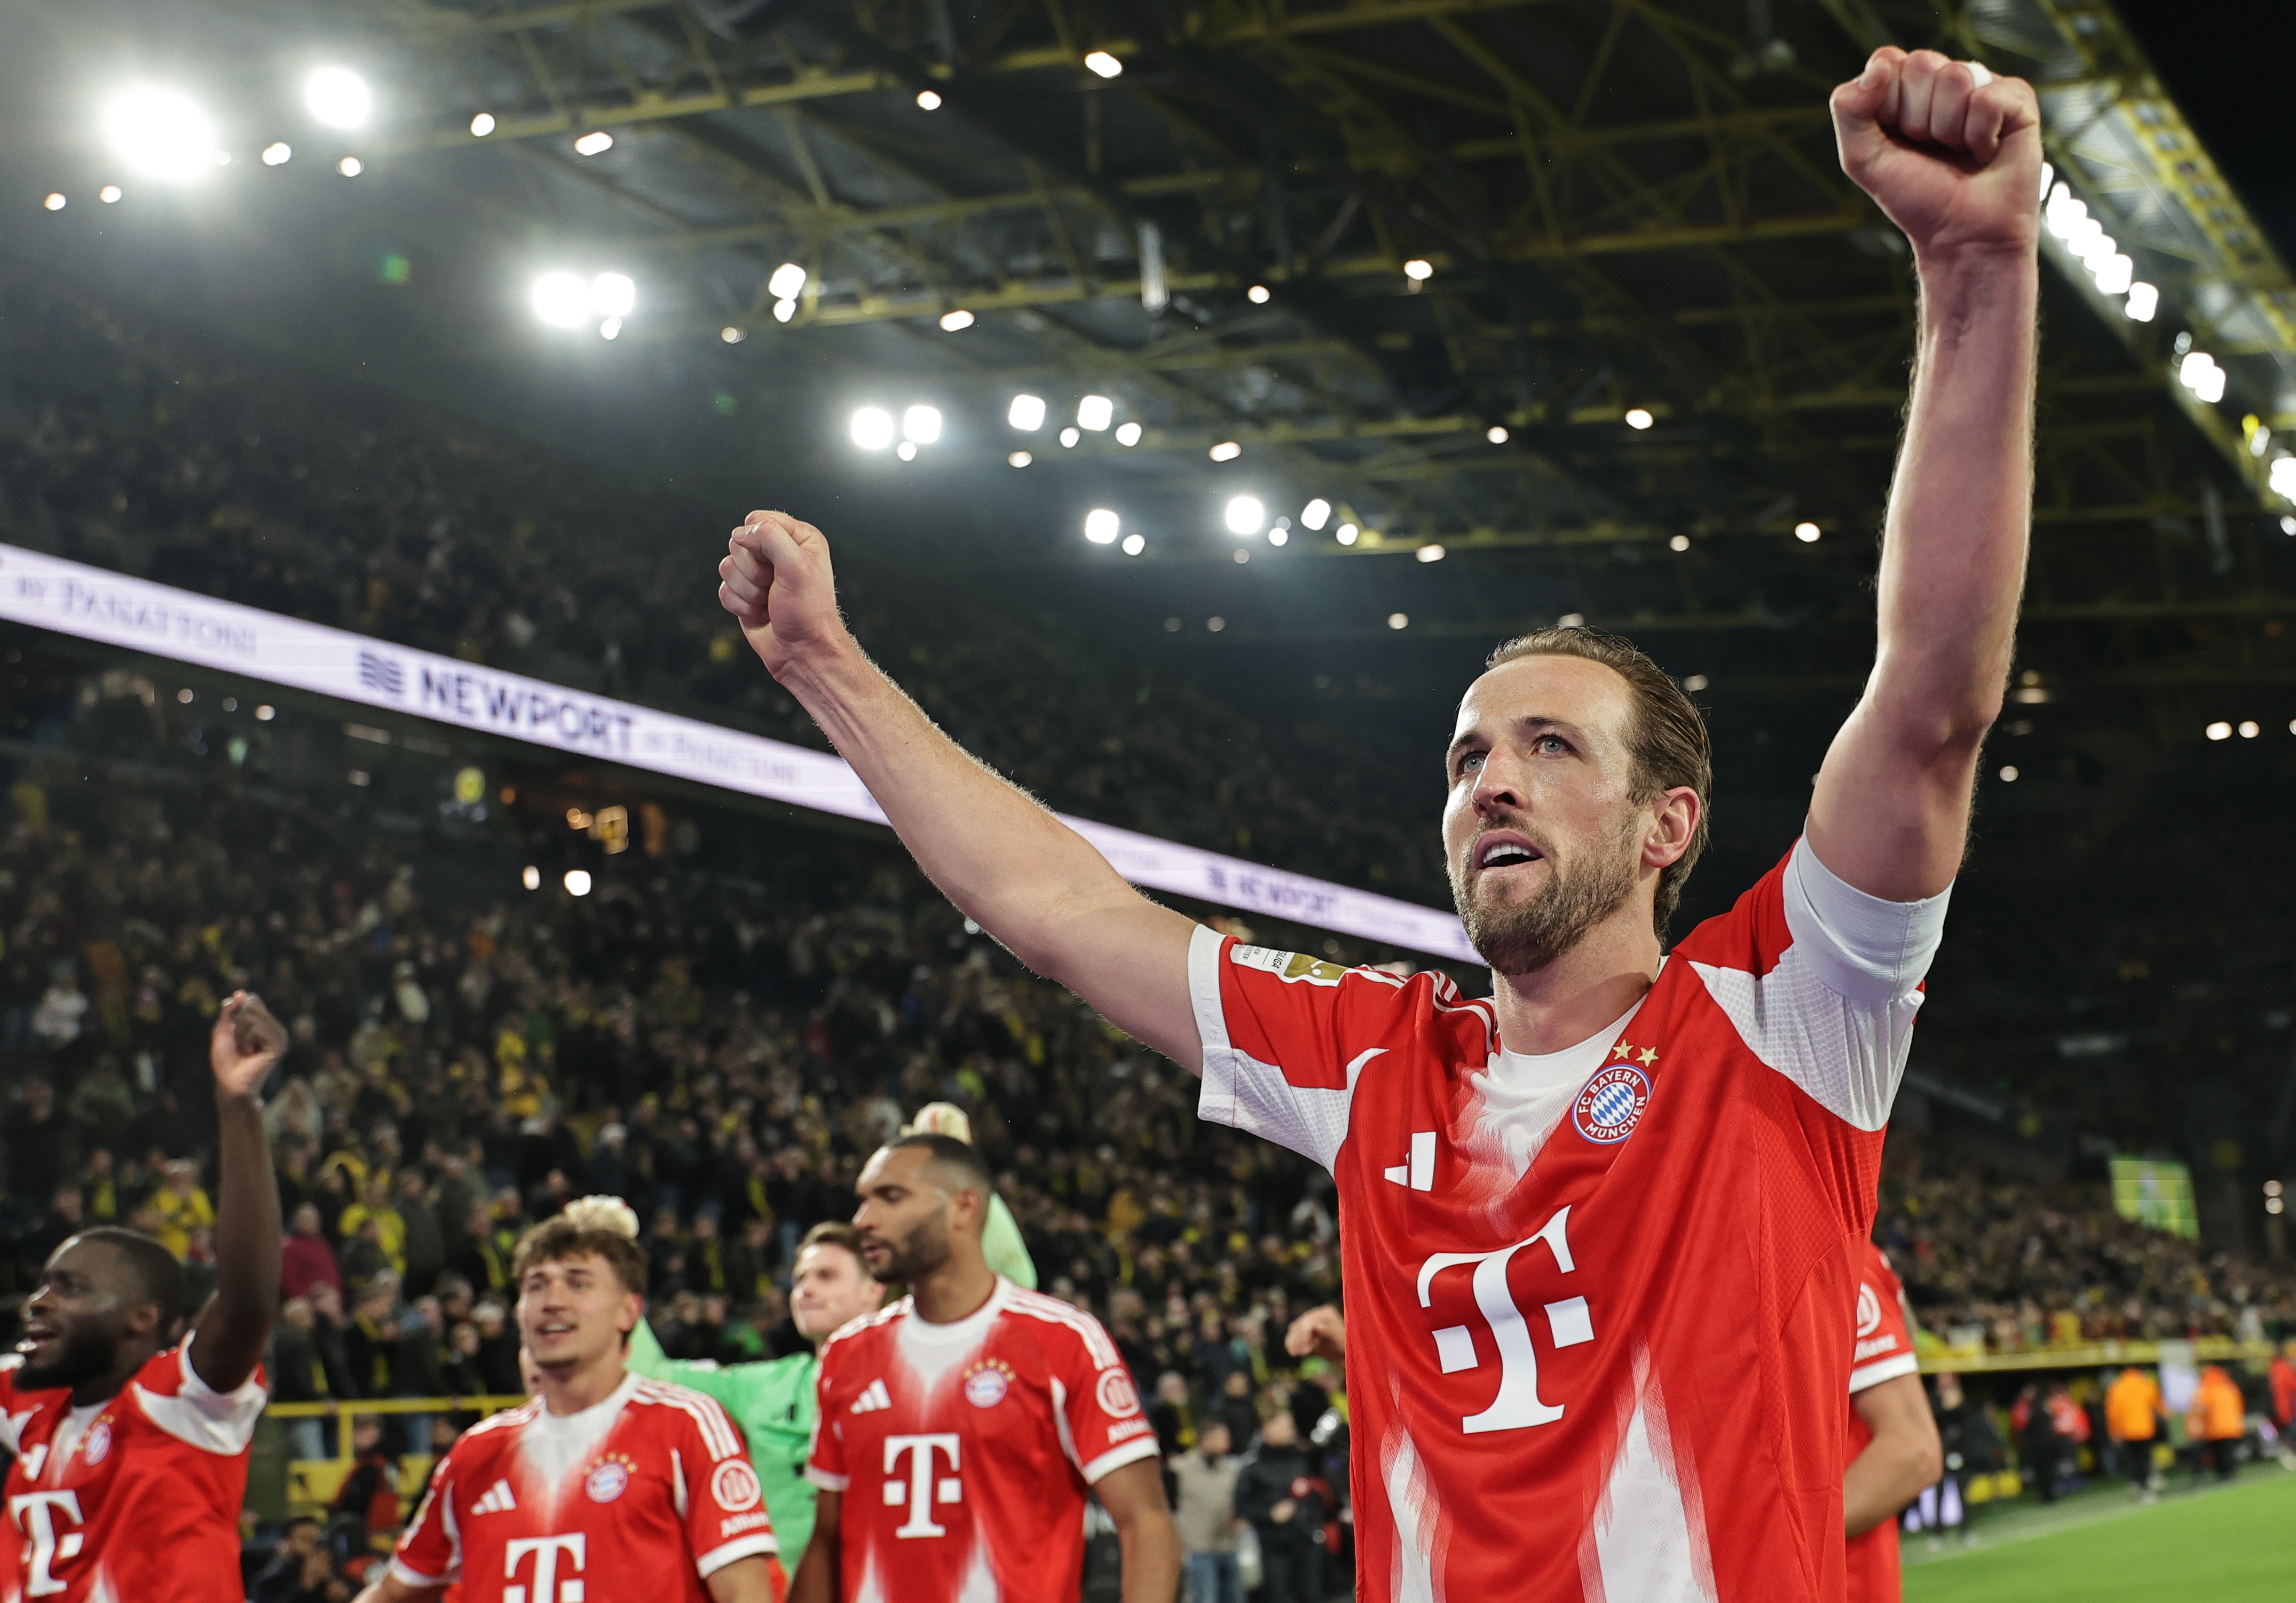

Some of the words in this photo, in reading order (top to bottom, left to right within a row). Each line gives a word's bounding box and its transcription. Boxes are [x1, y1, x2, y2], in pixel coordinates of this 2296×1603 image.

[419, 667, 635, 754] NEWPORT
[1271, 951, 1288, 969] SLIGA
[1579, 1096, 1591, 1113] FC
[1589, 1070, 1641, 1094] BAYERN
[1585, 1096, 1646, 1138] MÜNCHEN
